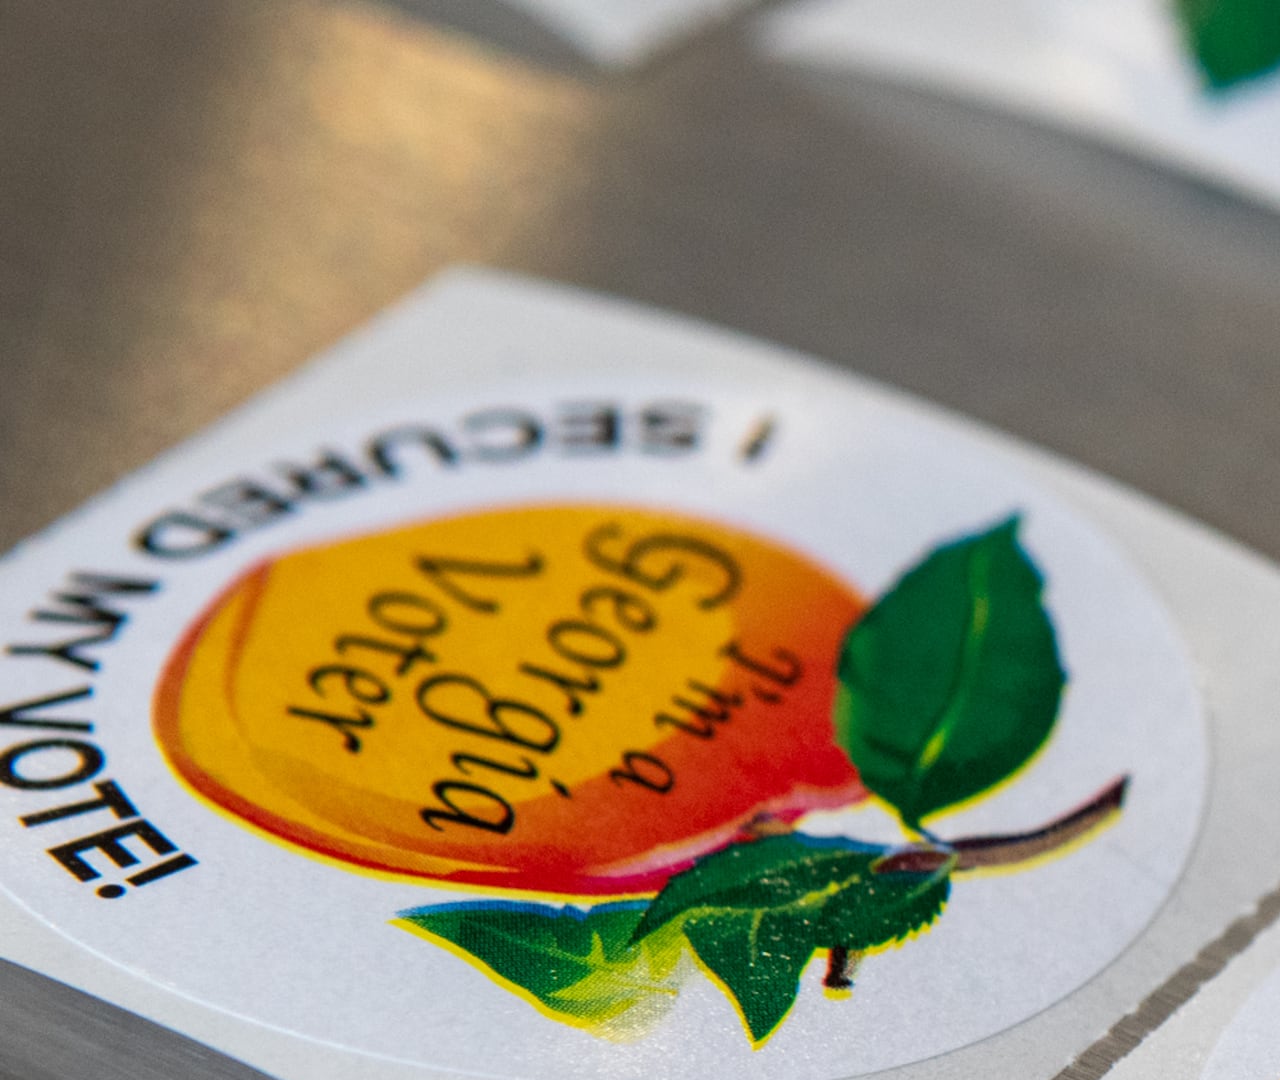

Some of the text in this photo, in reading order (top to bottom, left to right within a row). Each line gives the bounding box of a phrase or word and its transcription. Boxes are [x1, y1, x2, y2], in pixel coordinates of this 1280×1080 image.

[0, 401, 778, 900] I SECURED MY VOTE!
[287, 552, 547, 755] Voter
[416, 522, 744, 836] Georgia
[609, 750, 677, 796] a
